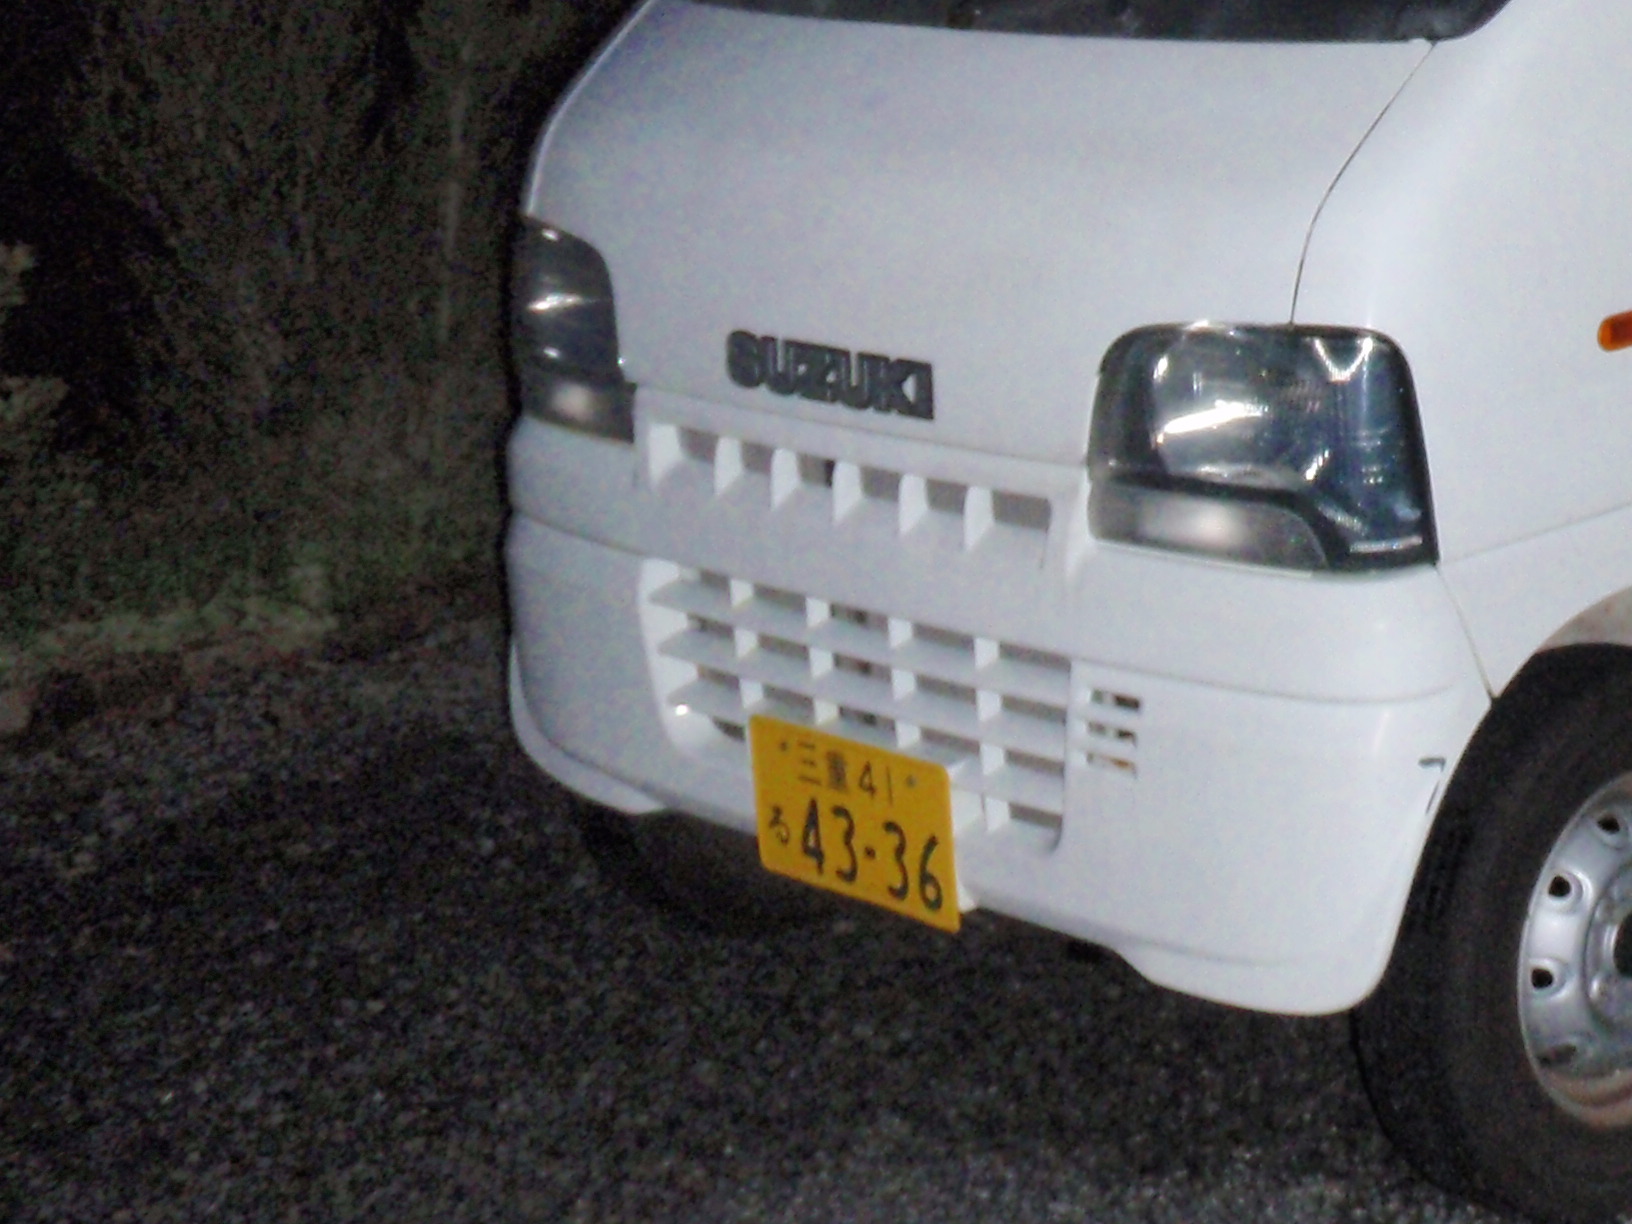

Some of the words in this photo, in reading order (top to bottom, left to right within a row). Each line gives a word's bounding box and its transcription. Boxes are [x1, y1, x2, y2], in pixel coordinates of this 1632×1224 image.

[726, 329, 934, 421] SUZUKI
[859, 760, 894, 807] 41
[802, 797, 942, 911] 43-36
